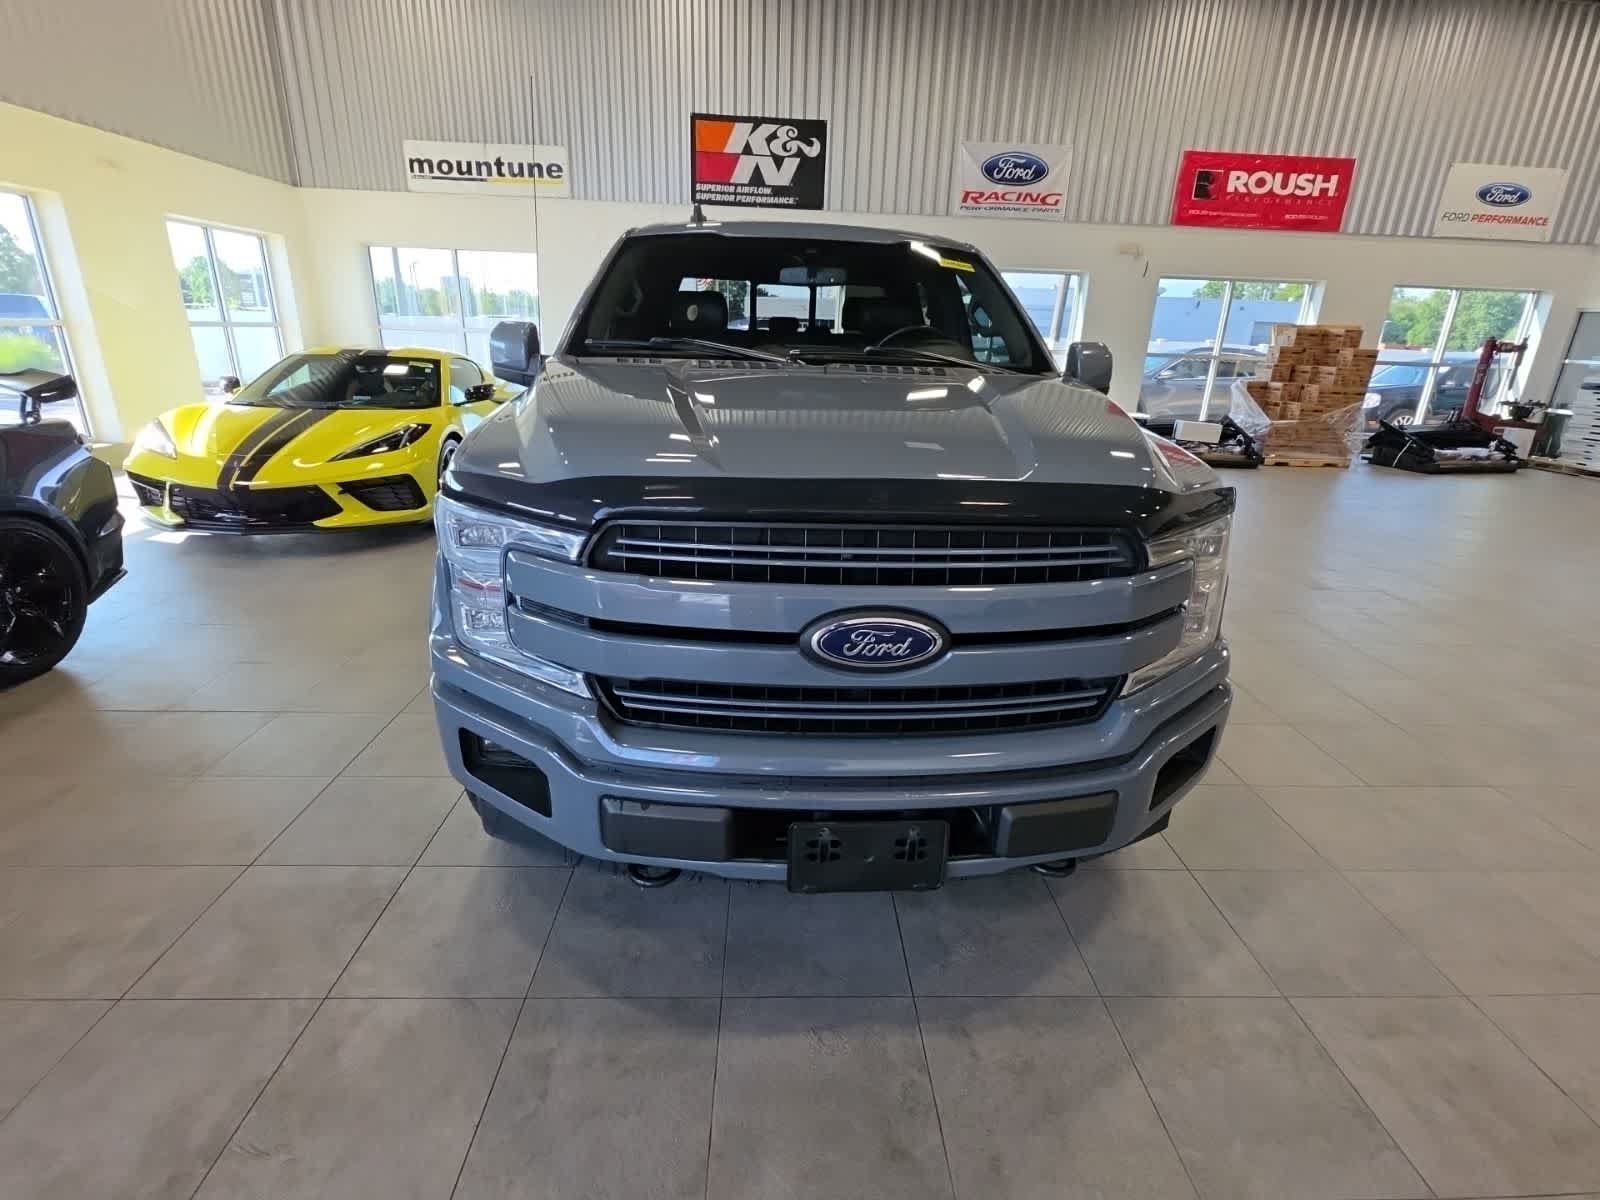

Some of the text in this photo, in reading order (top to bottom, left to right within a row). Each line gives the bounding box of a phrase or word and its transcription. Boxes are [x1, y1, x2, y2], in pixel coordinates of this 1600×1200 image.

[408, 156, 564, 179] mountune
[993, 157, 1037, 180] Ford
[695, 183, 735, 193] SUPERIOR
[1226, 170, 1339, 197] ROUSH
[695, 192, 735, 202] SUPERIOR
[961, 190, 1063, 207] RACING
[1485, 185, 1522, 203] Ford
[959, 205, 1028, 213] PERFORMANCE
[1441, 211, 1549, 227] FORD PERFORMANCE
[843, 629, 913, 657] Ford
